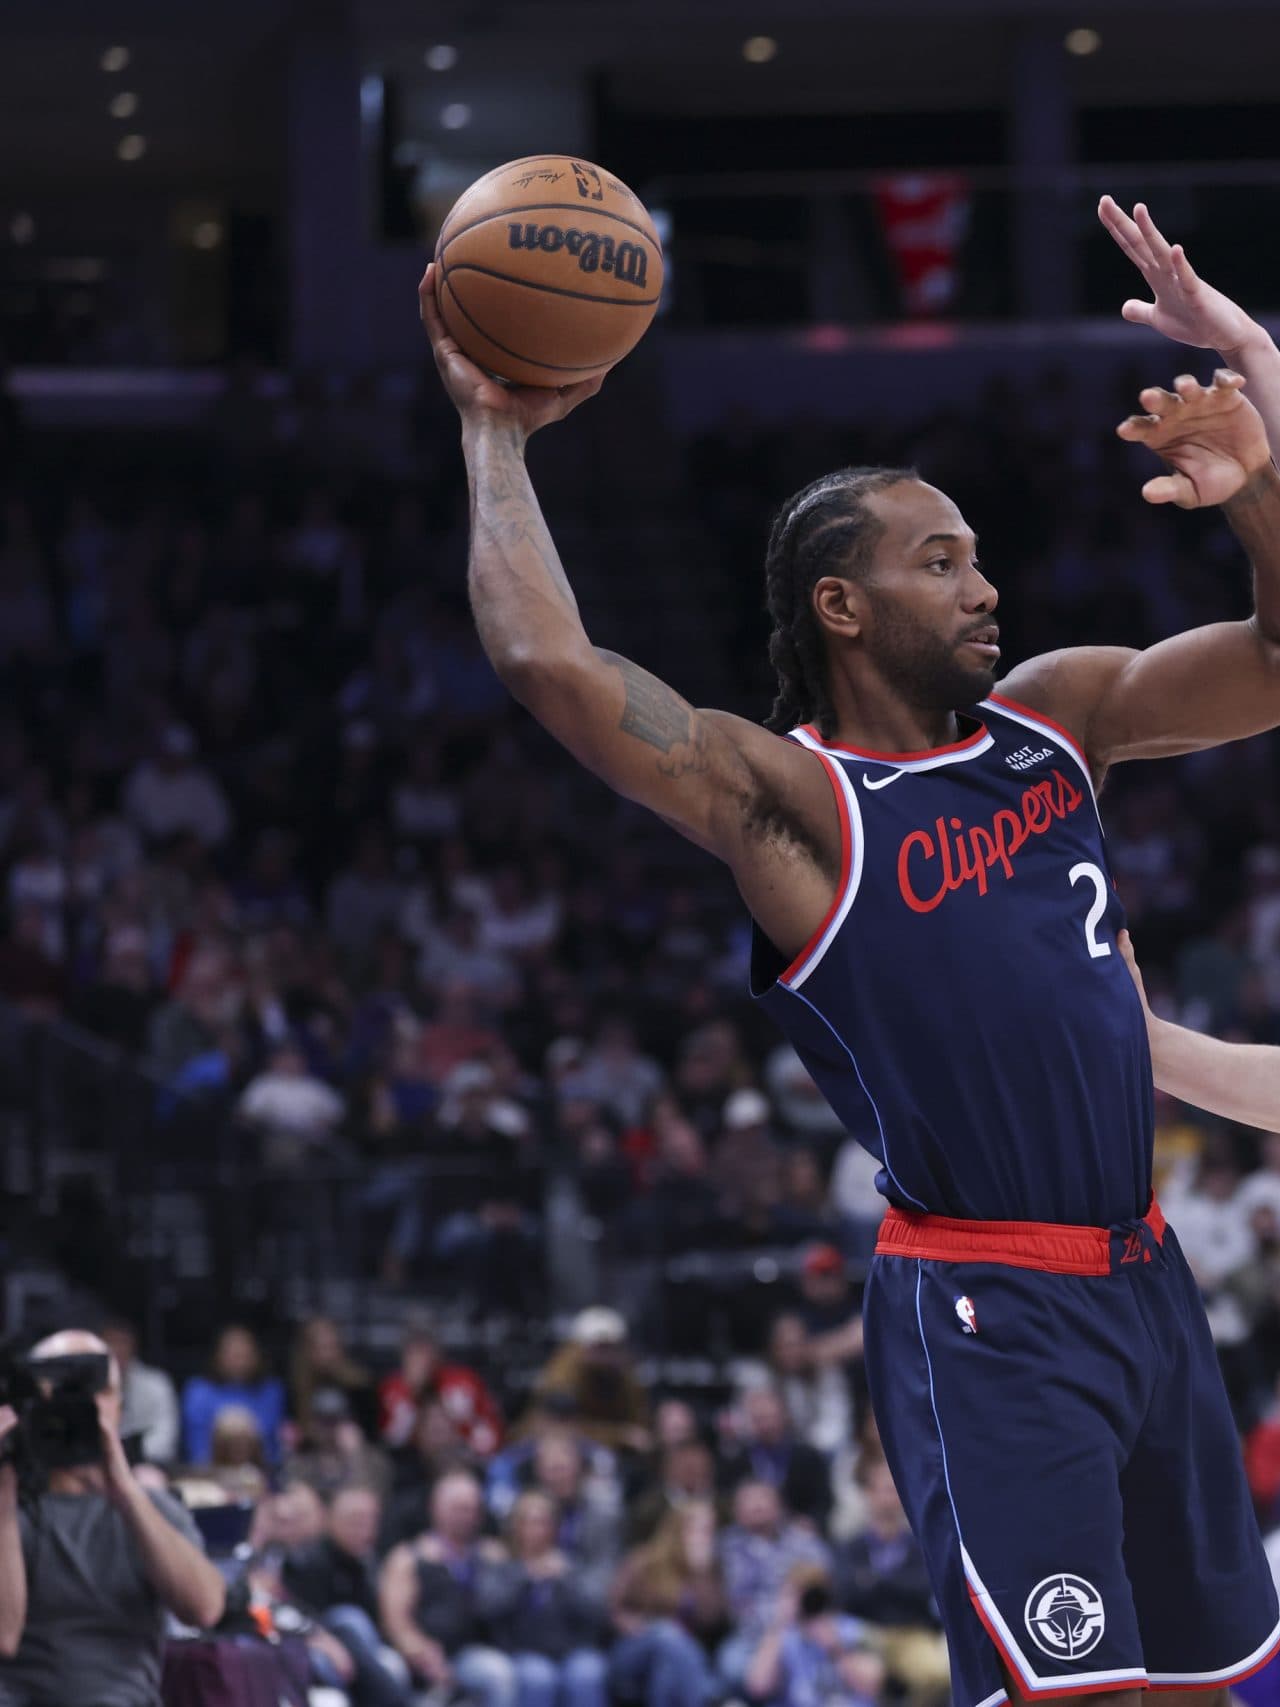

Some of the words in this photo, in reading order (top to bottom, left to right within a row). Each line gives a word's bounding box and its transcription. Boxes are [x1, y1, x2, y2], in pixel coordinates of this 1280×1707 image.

[508, 223, 648, 290] Wilson
[1005, 746, 1034, 765] VISIT
[898, 769, 1083, 913] Clippers
[1068, 861, 1111, 958] 2
